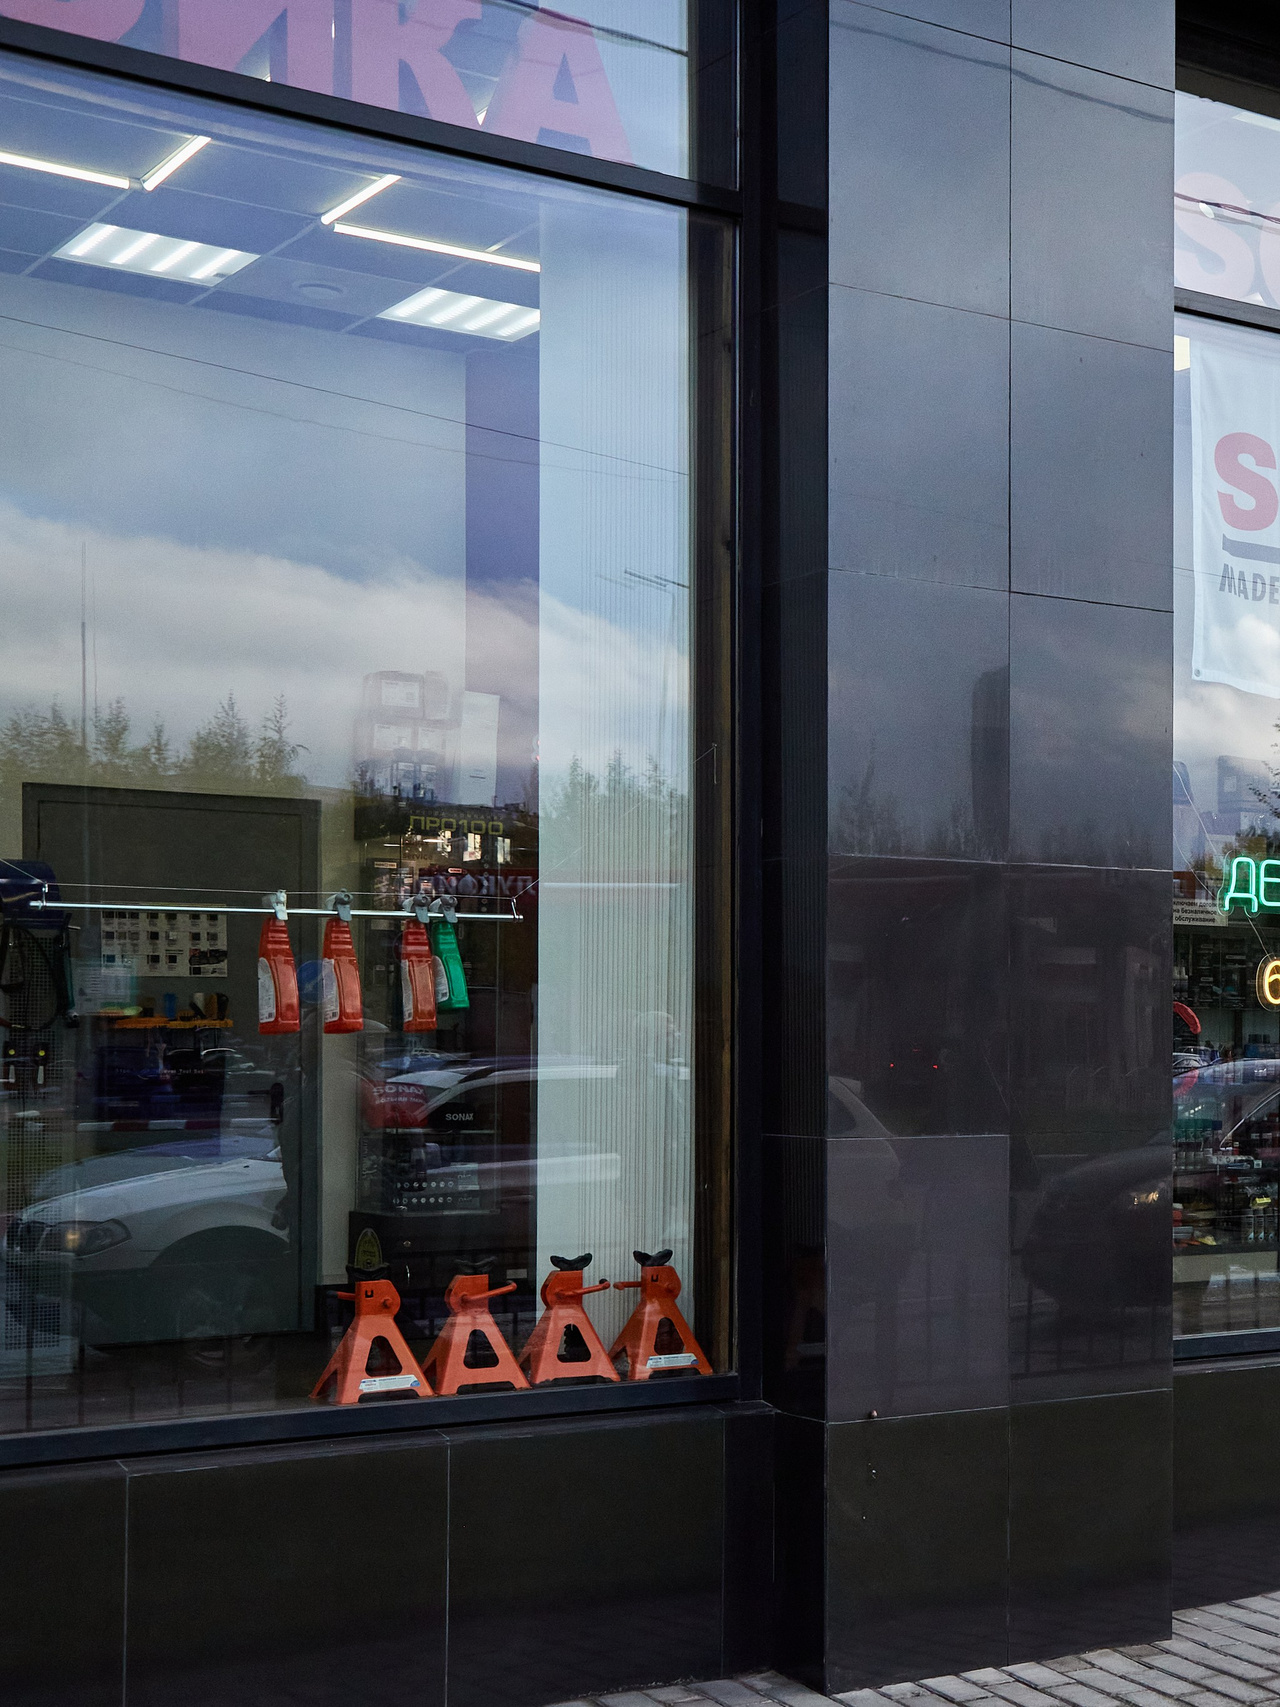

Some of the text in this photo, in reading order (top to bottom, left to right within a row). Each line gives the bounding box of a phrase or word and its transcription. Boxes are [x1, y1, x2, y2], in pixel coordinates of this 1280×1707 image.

[1219, 563, 1280, 605] MADE
[409, 815, 504, 835] ПРО100
[445, 1112, 474, 1121] SONAX
